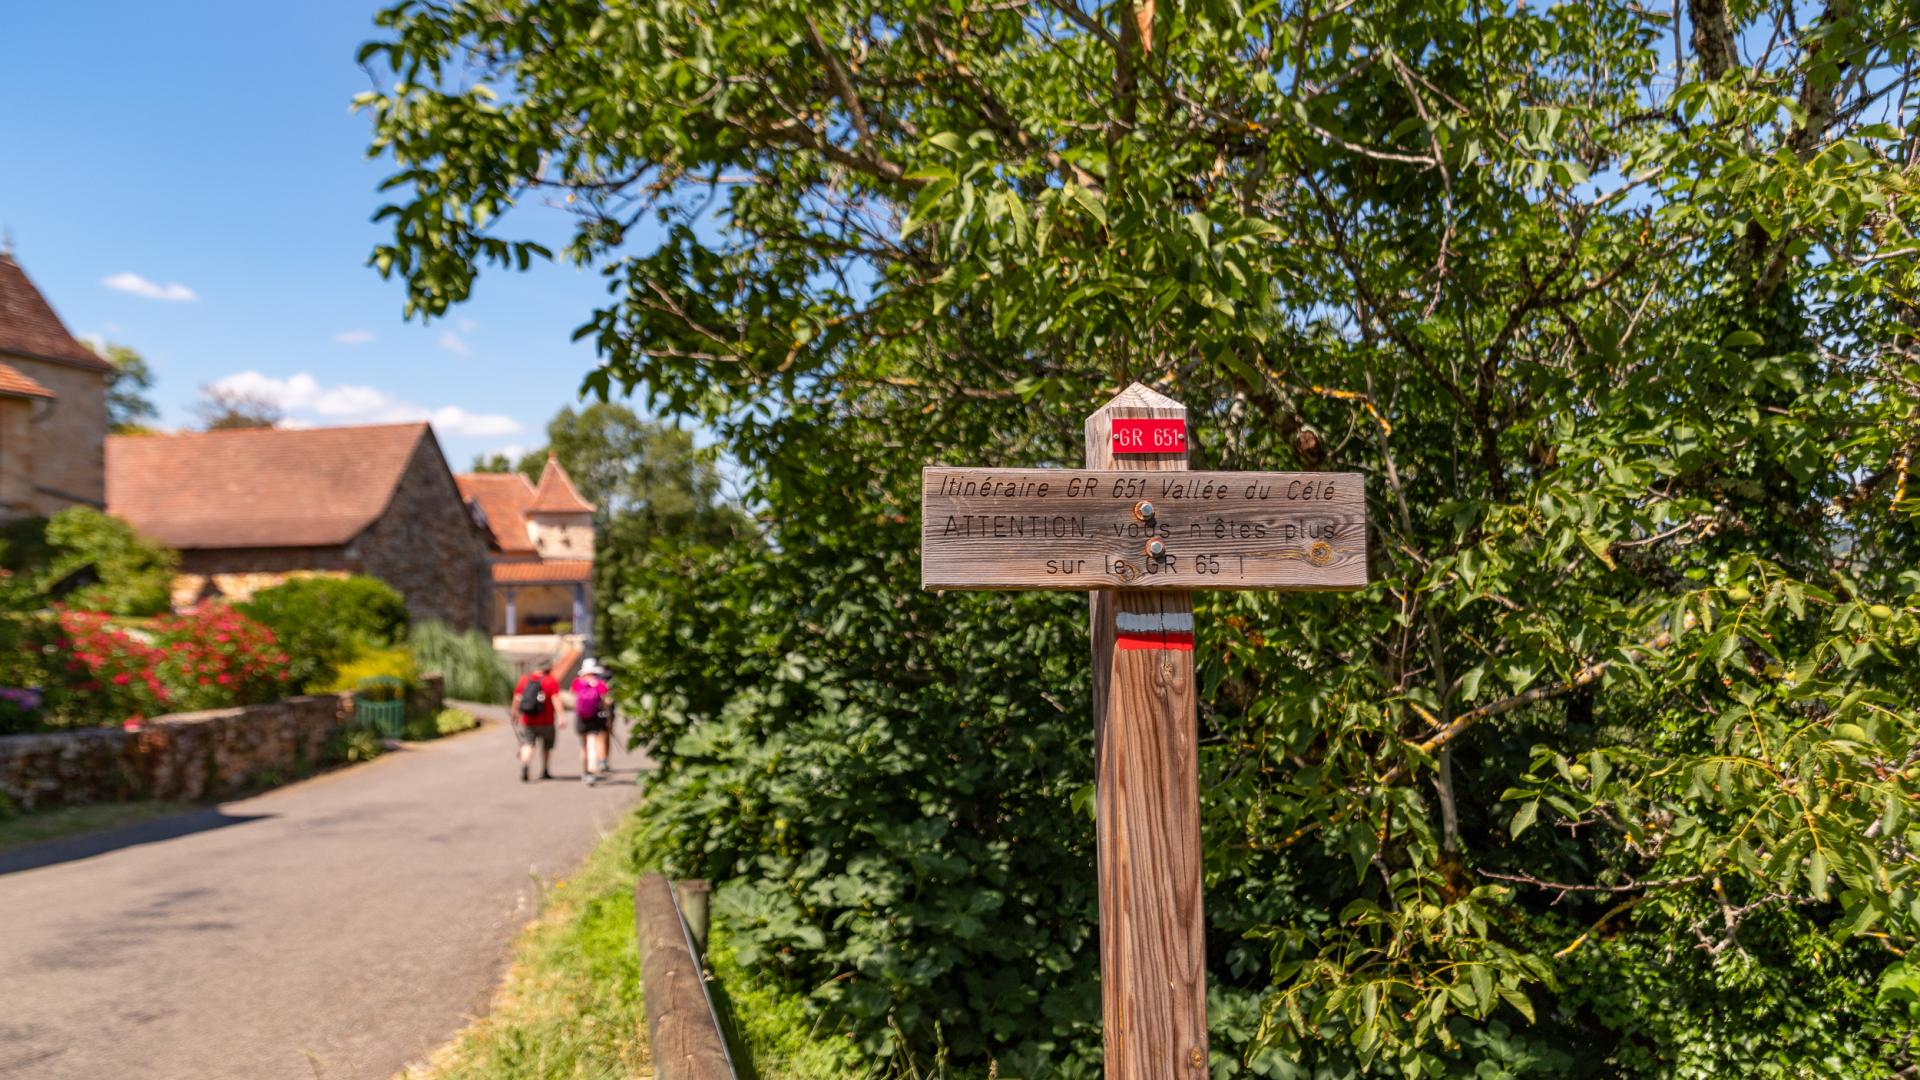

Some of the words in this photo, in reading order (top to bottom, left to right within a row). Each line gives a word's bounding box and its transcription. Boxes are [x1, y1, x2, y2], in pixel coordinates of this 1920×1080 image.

[1120, 428, 1143, 446] GR
[1154, 428, 1178, 446] 651
[939, 475, 1049, 497] Itinéraire
[1067, 477, 1098, 498] GR
[1112, 478, 1146, 498] 651
[1161, 479, 1228, 499] Vallée
[1245, 480, 1271, 499] du
[1287, 480, 1335, 500] Célé
[1190, 517, 1266, 538] n'êtes
[1285, 519, 1335, 544] plus
[1046, 560, 1085, 574] sur
[1104, 555, 1125, 574] le
[1146, 554, 1177, 574] GR
[1195, 555, 1220, 574] 65
